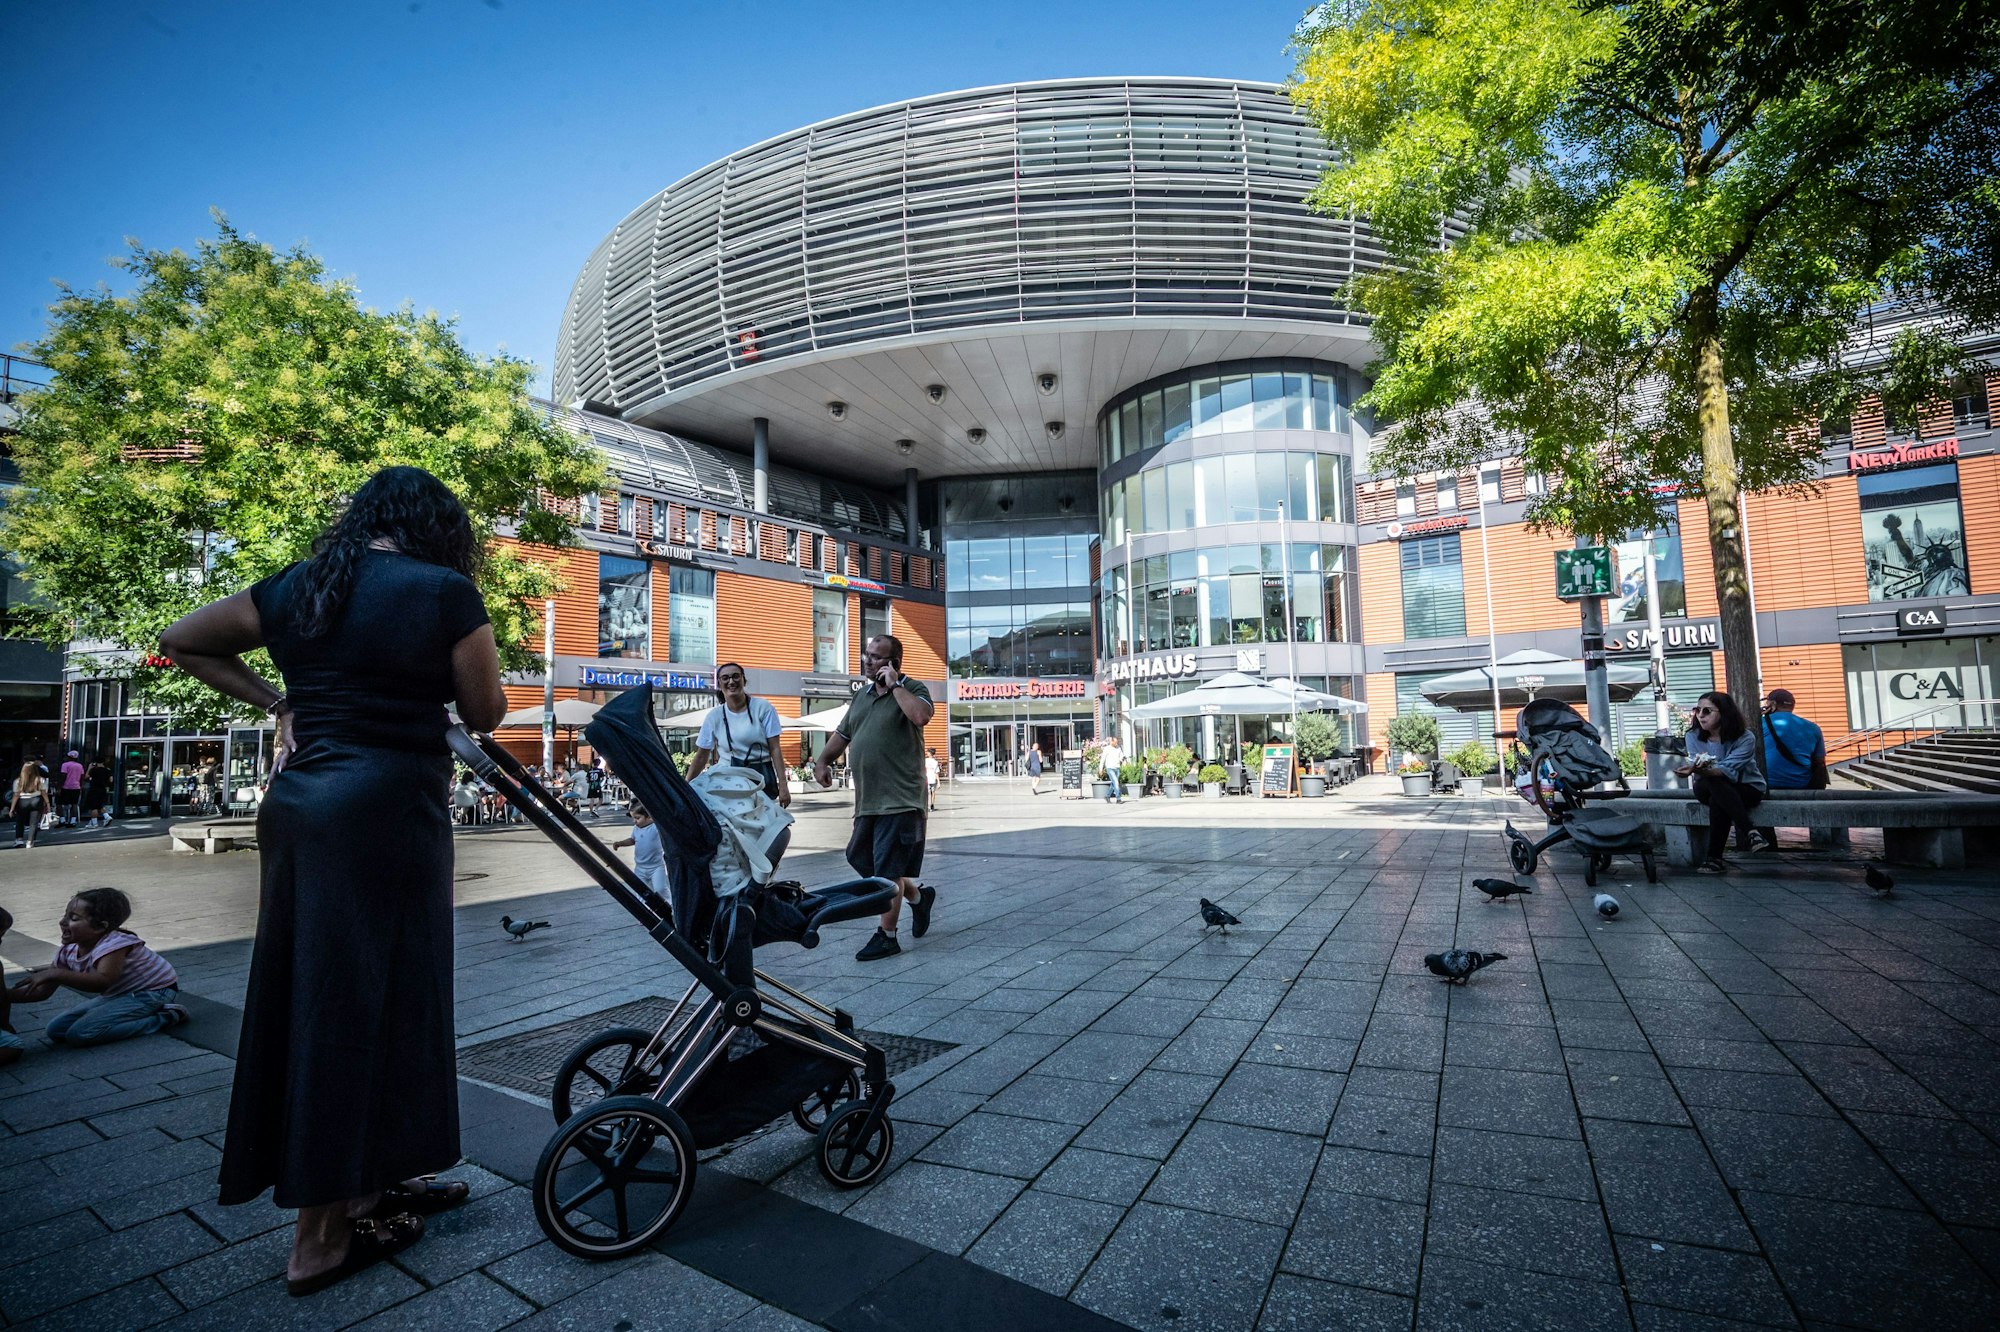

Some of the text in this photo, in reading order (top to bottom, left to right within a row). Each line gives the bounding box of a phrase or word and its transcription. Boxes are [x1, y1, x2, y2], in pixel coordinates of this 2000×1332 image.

[1407, 516, 1468, 532] vodafone
[657, 543, 693, 561] SATURN
[1904, 578, 1918, 588] WAY
[1905, 610, 1941, 626] C&A
[1111, 653, 1197, 681] RATHAUS
[583, 667, 706, 689] Deutsche Bank
[1889, 671, 1965, 701] C&A
[1028, 679, 1085, 697] GALERIE
[590, 773, 599, 781] 20
